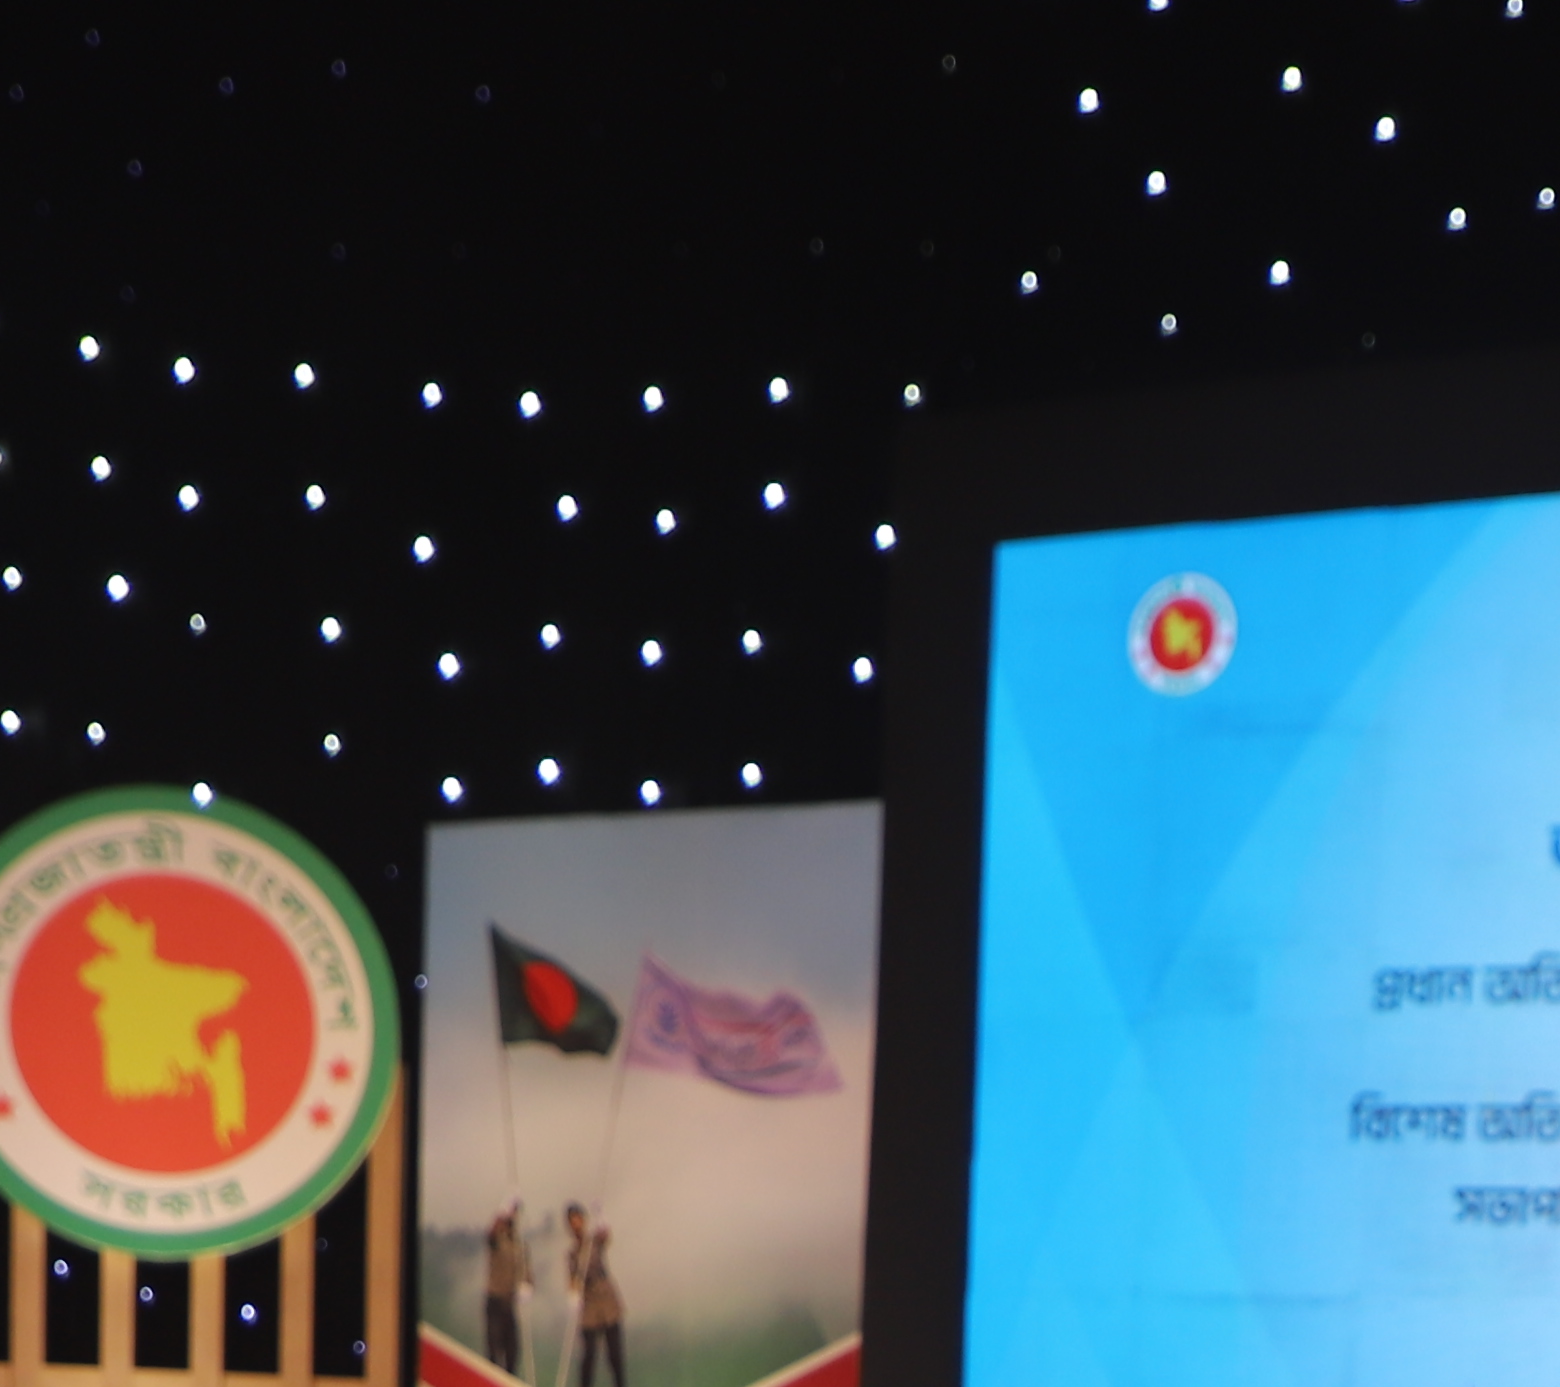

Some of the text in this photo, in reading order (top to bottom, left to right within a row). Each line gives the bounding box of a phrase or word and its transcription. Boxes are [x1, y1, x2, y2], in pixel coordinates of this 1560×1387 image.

[1374, 962, 1475, 1012] প্রধান
[1348, 1091, 1466, 1143] বিশেষ
[80, 1168, 249, 1219] সরকার
